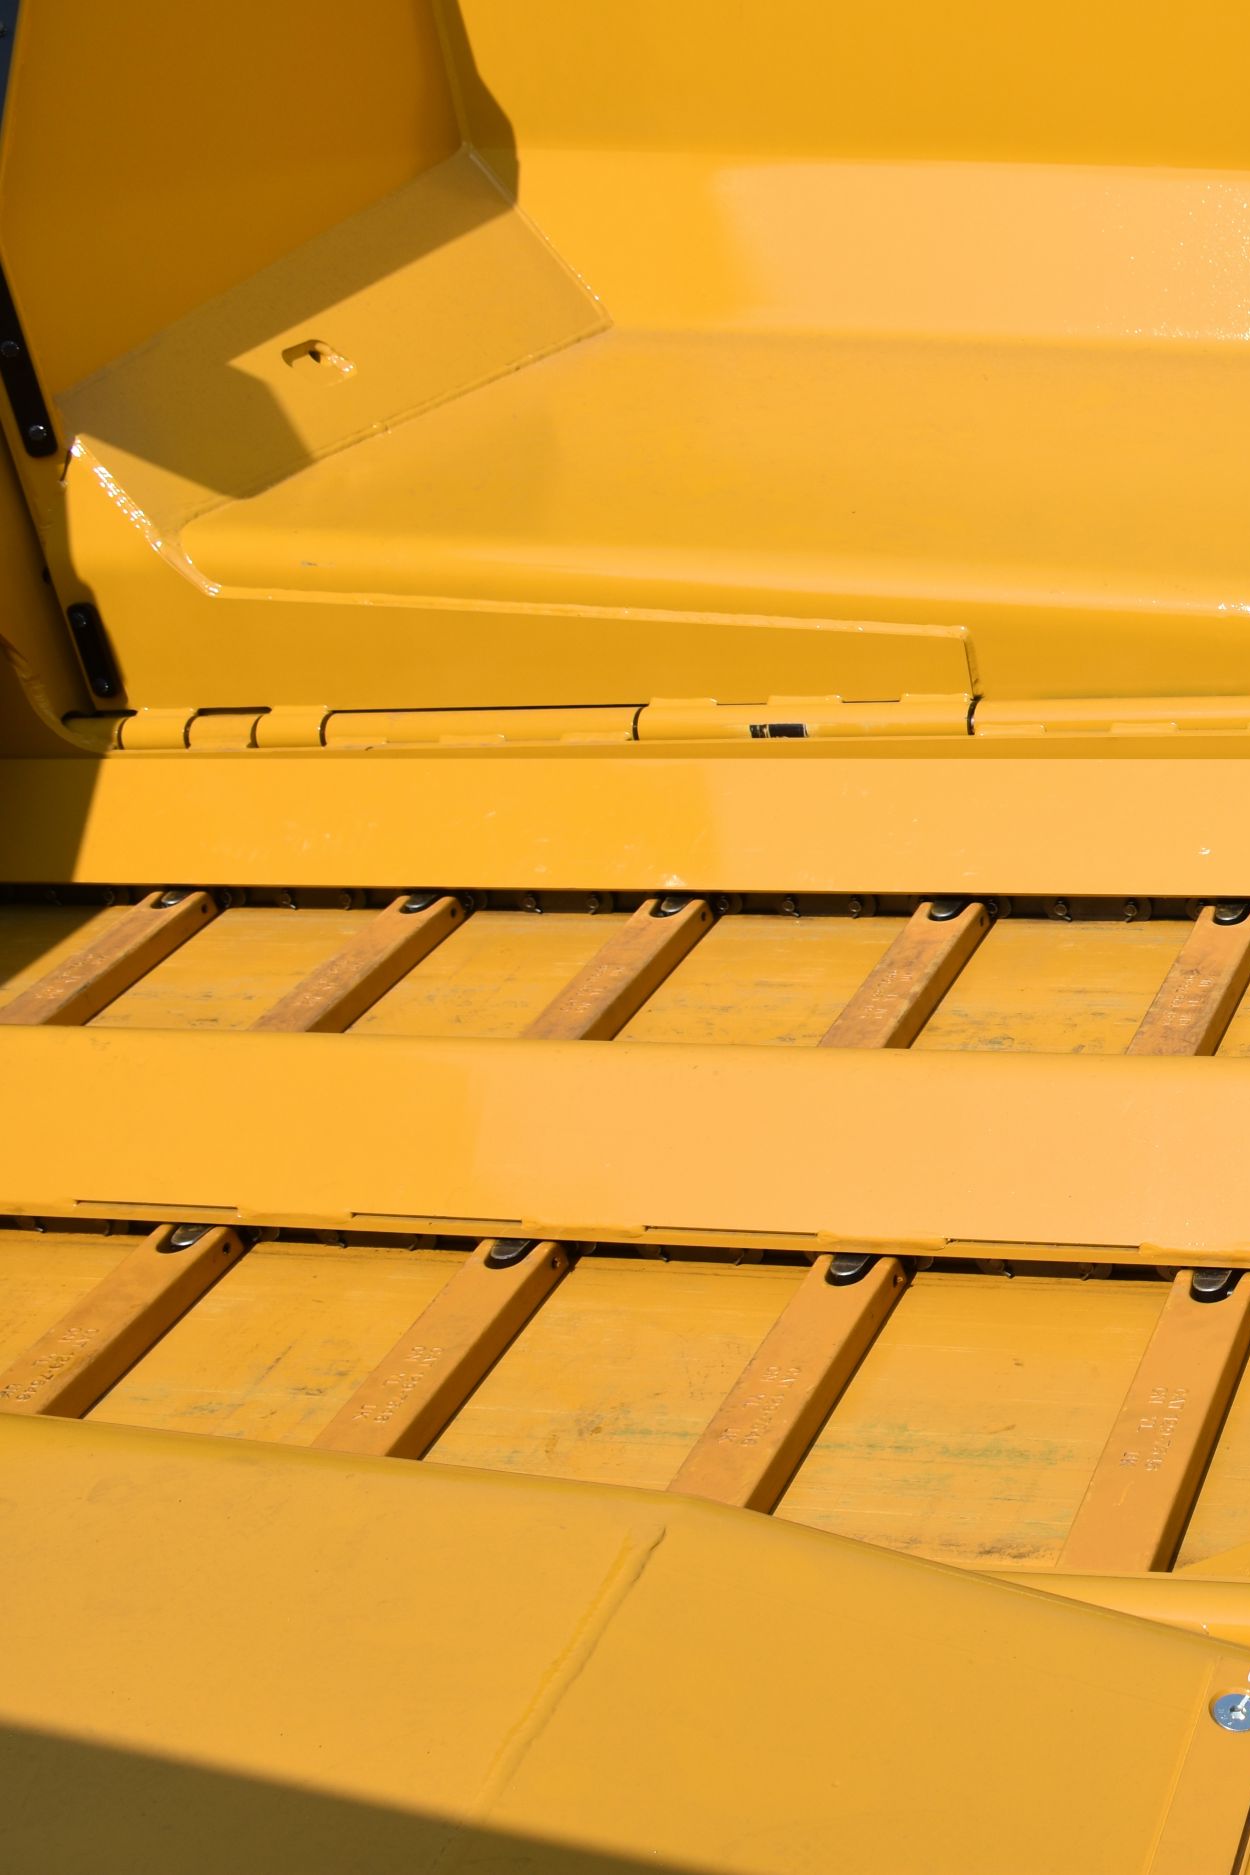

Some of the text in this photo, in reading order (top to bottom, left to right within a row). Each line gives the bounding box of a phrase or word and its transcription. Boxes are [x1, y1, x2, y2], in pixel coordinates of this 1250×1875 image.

[418, 1347, 444, 1367] CAT
[776, 1367, 801, 1389] CAT
[1167, 1386, 1189, 1409] CAT
